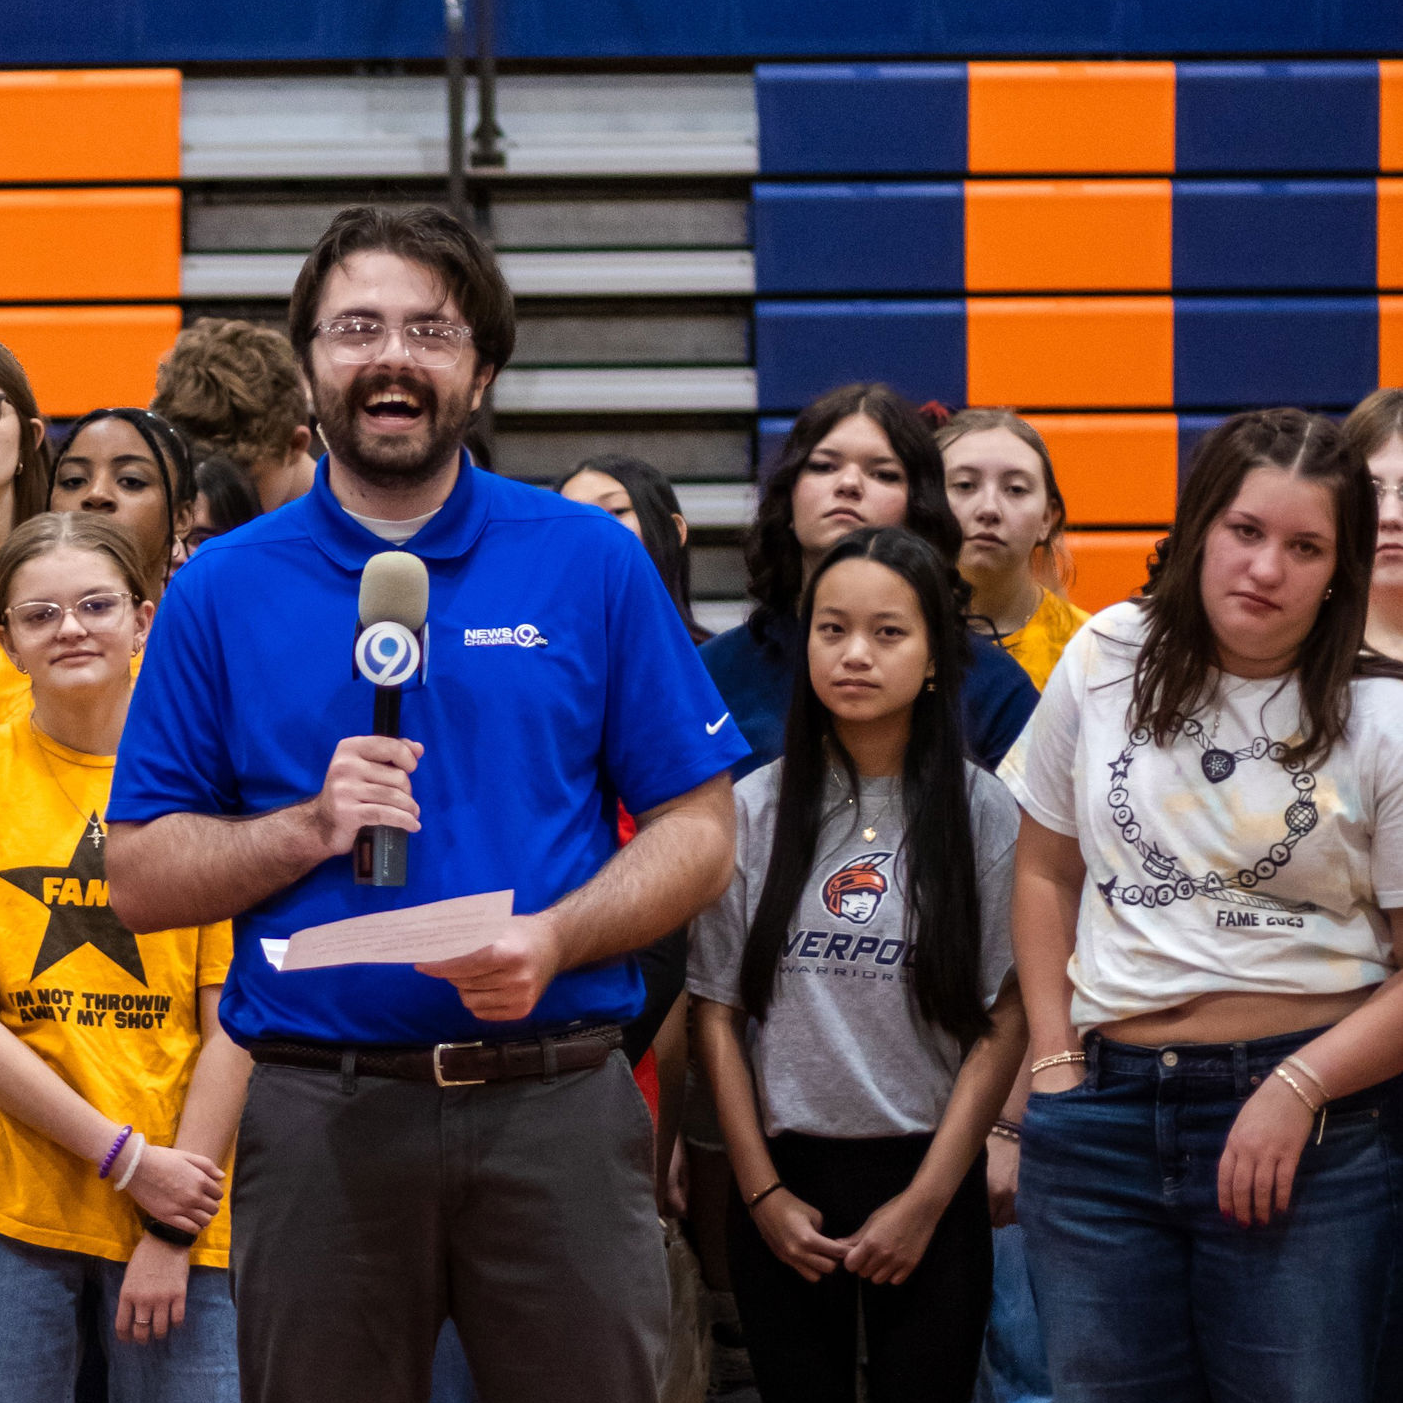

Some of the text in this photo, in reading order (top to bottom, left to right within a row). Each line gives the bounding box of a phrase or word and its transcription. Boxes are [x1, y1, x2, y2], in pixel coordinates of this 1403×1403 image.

[463, 627, 513, 639] NEWS
[463, 637, 515, 646] CHANNEL
[515, 625, 538, 647] 9
[43, 876, 110, 907] FAM
[1216, 910, 1260, 927] FAME
[779, 965, 910, 983] WARRIORS
[37, 988, 74, 1006] NOT
[20, 1005, 166, 1029] AWAY MY SHOT
